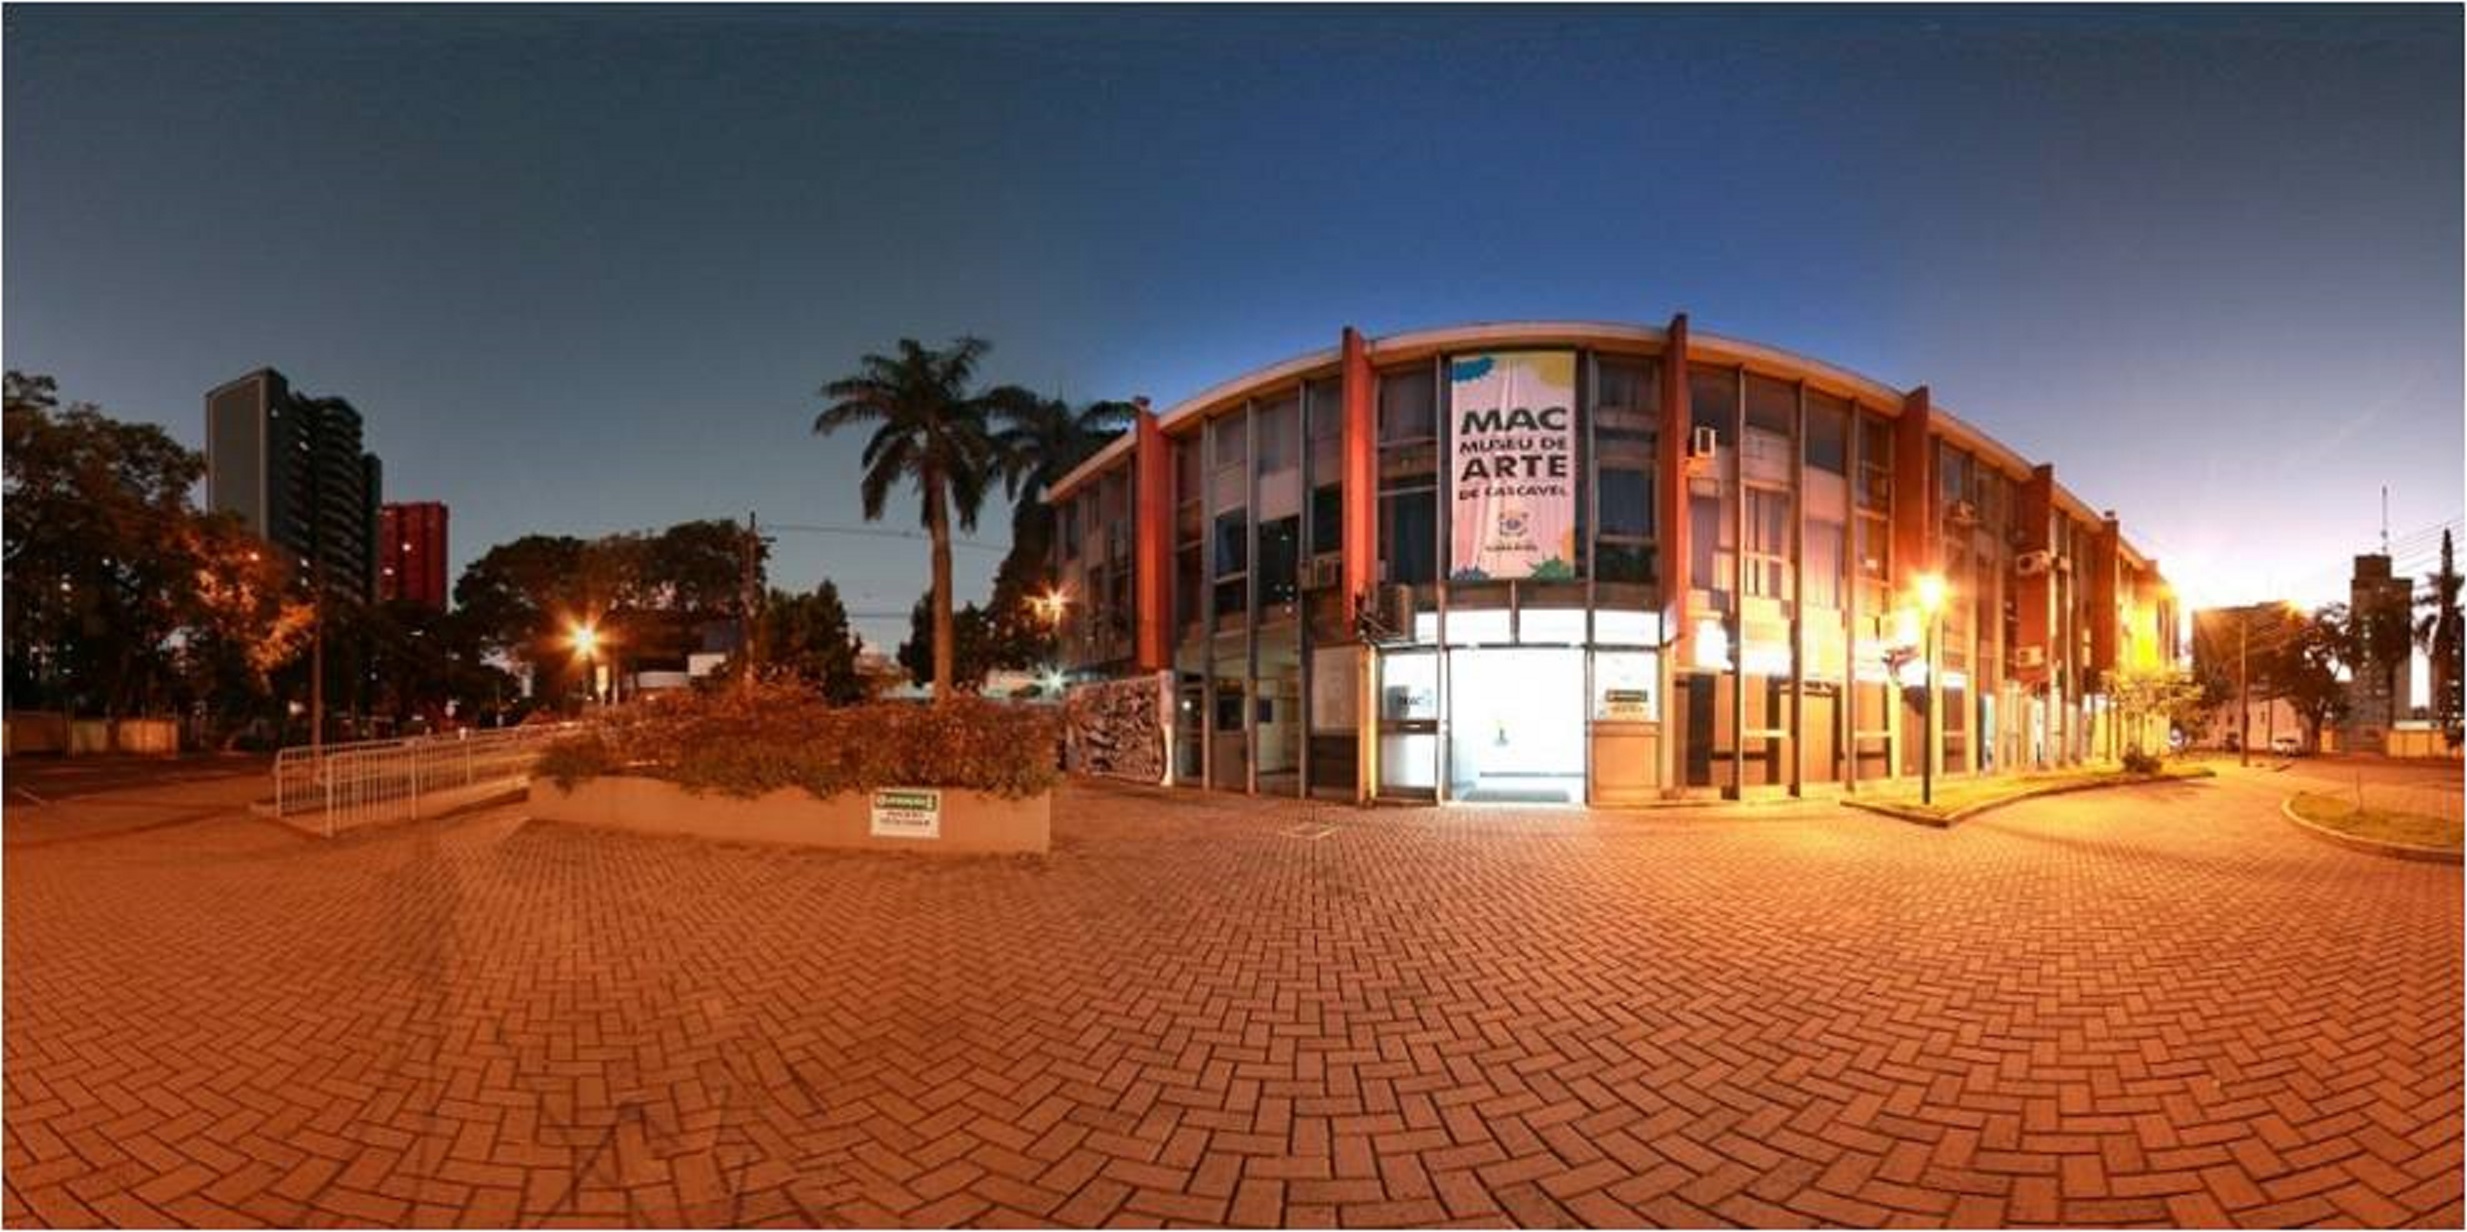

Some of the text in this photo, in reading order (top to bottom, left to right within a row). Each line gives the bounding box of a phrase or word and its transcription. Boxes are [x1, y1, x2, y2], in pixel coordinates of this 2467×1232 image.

[1460, 407, 1568, 435] MAC
[1459, 436, 1567, 454] MUSEU DE
[1460, 455, 1568, 482] ARTE
[1458, 484, 1568, 501] DE CASCAVEL
